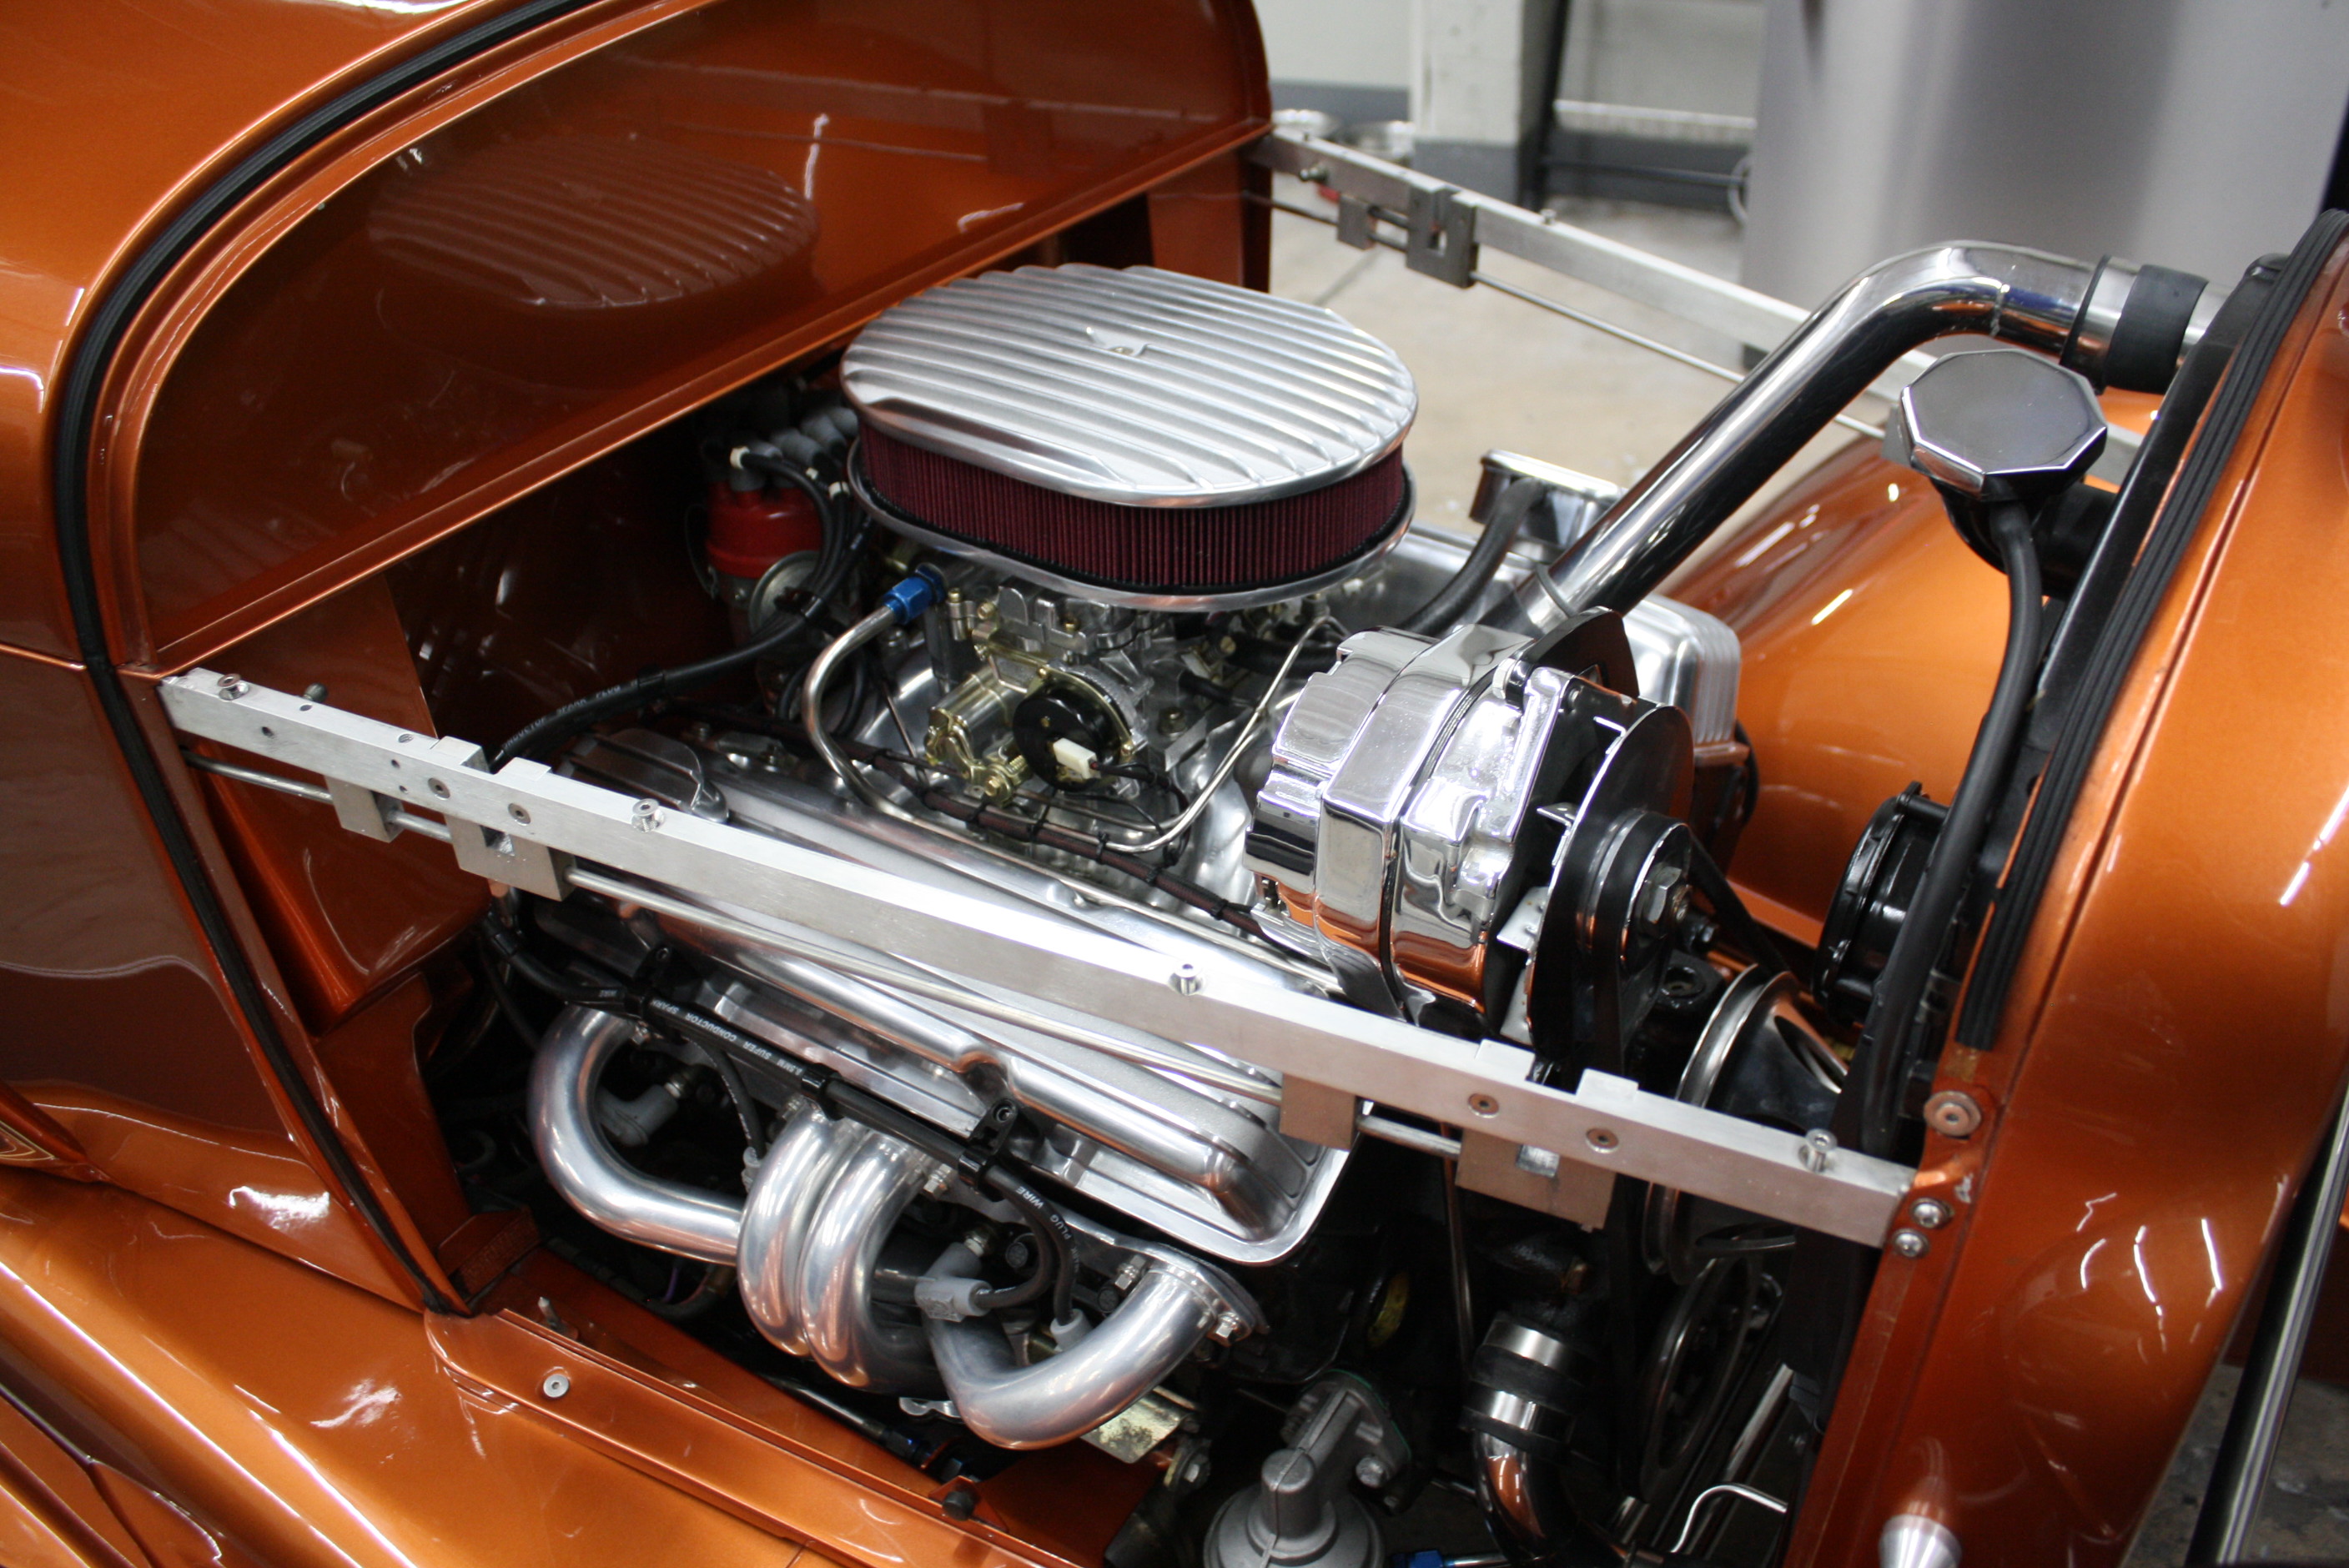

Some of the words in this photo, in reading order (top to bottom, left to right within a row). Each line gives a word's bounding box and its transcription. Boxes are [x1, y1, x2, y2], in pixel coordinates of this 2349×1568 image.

[651, 999, 680, 1014] SPARK
[685, 1013, 737, 1042] CONDUCTOR
[742, 1041, 772, 1060] SUPER
[1016, 1185, 1044, 1209] WIRE
[1050, 1214, 1073, 1240] PLUG
